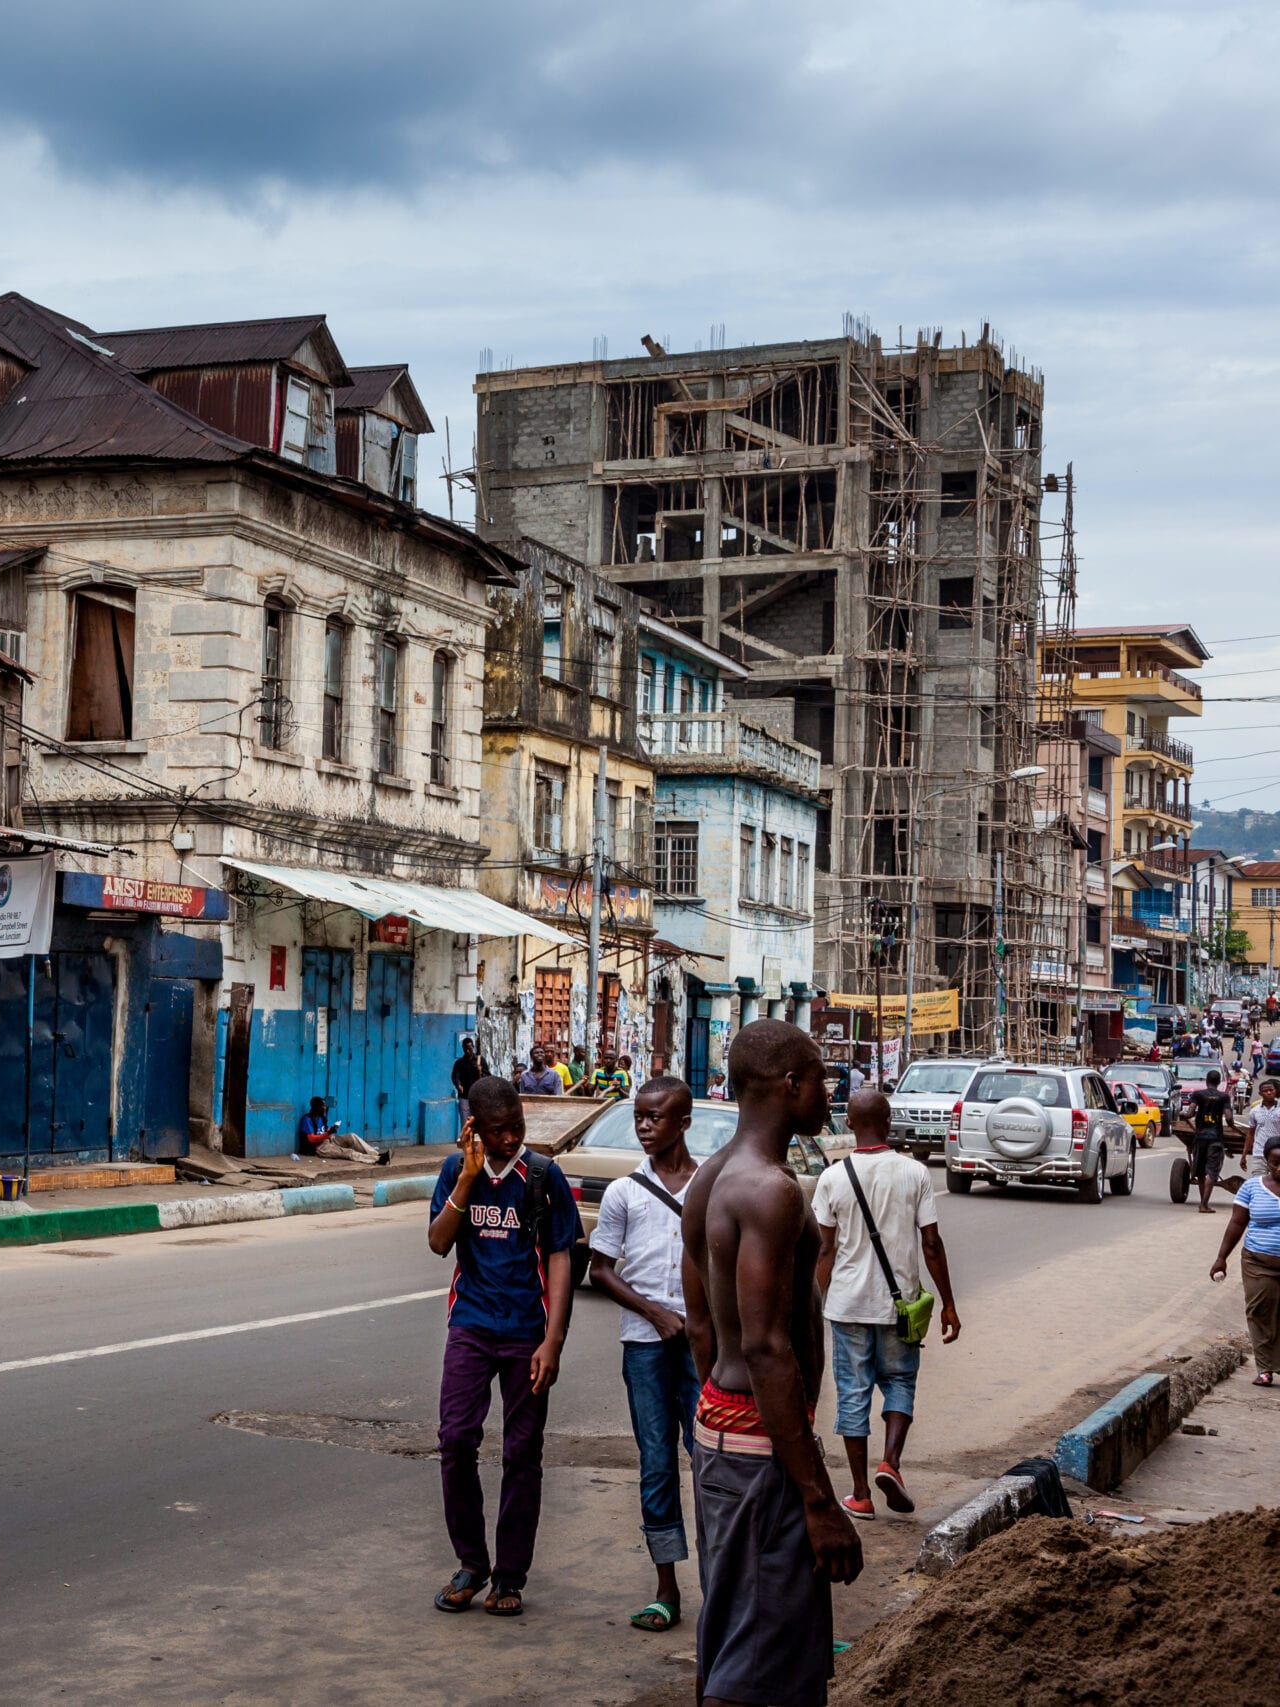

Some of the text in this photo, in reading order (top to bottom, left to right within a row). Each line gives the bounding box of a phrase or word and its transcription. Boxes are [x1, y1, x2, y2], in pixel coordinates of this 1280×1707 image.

[103, 876, 193, 904] ANSU ENTERPRISES
[0, 922, 16, 930] Campbell
[16, 922, 28, 930] Street
[992, 1121, 1042, 1133] SUZUKI
[470, 1205, 521, 1228] USA
